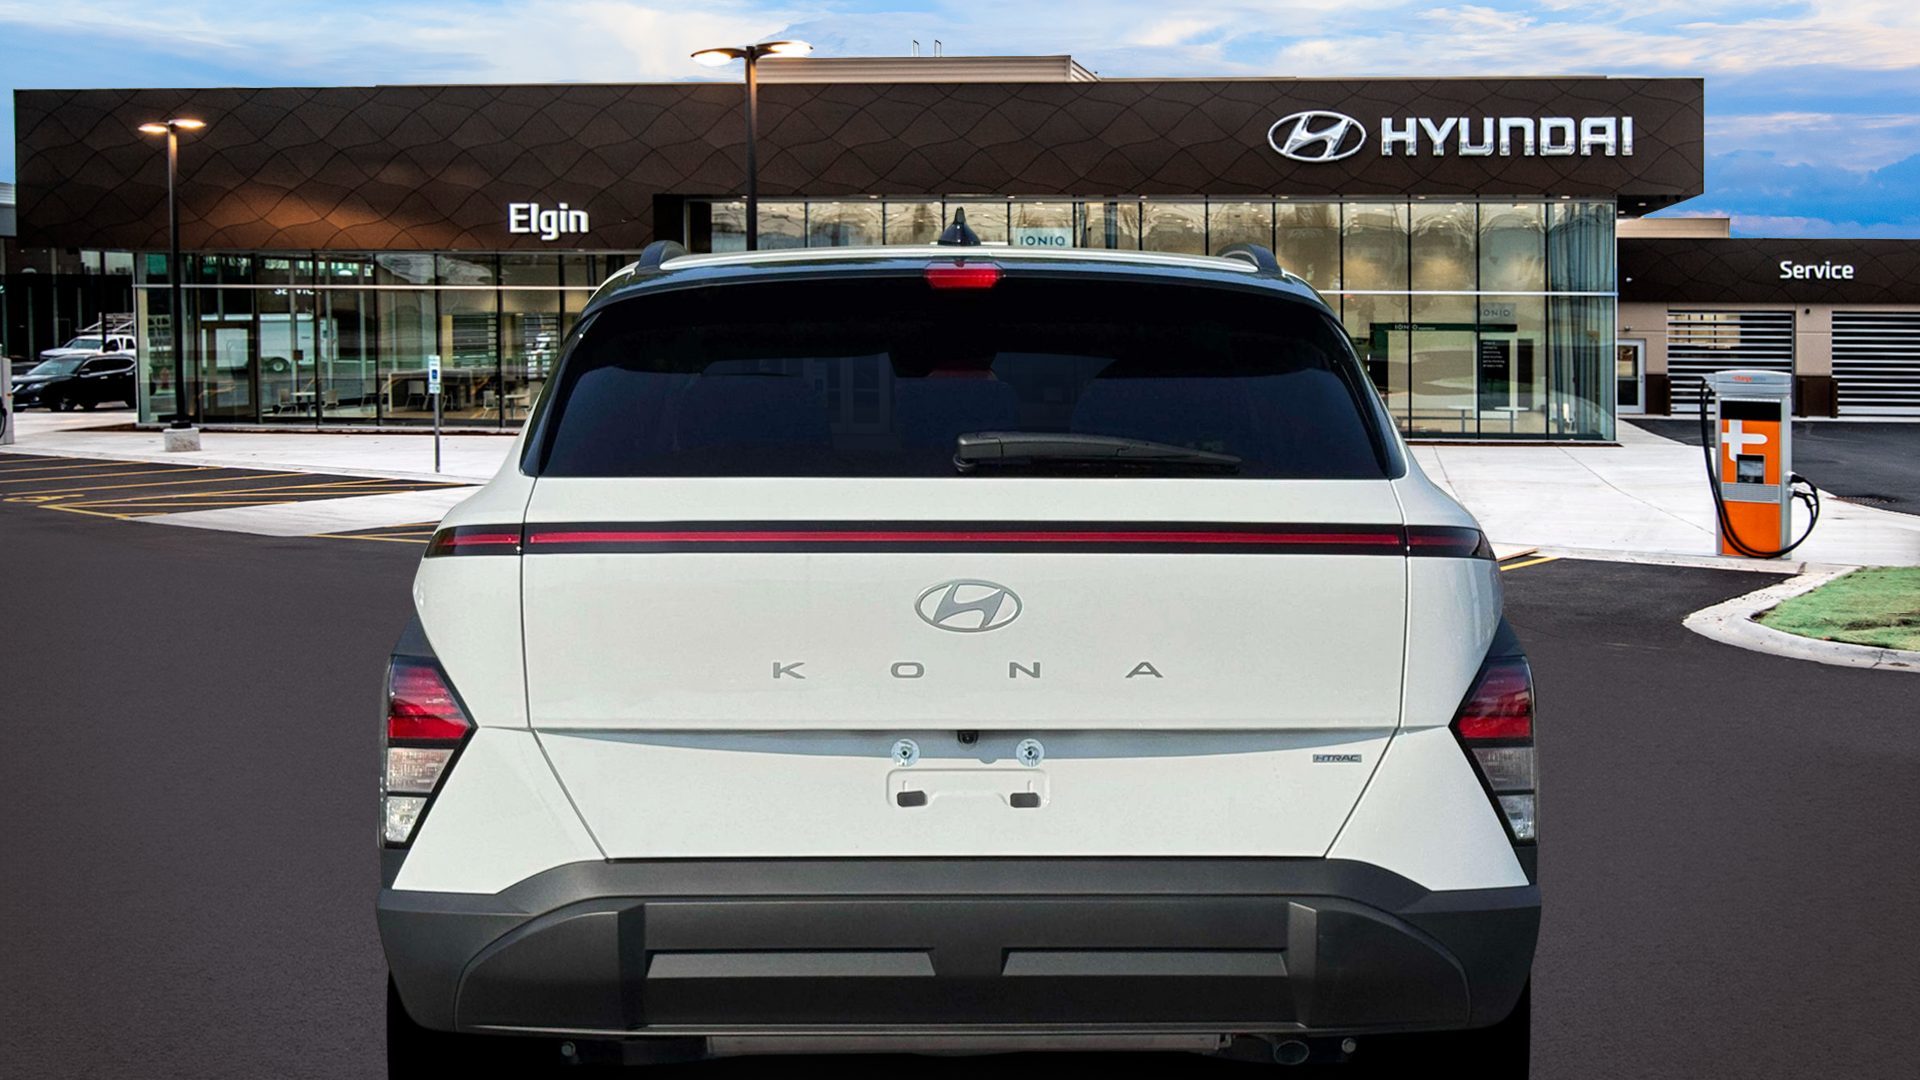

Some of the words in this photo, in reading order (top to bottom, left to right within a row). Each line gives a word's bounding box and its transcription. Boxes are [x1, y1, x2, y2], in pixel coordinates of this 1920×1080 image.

[1380, 116, 1634, 157] HYUNDAI
[508, 202, 589, 241] Elgin
[1020, 235, 1066, 247] IONIQ
[1779, 260, 1855, 280] Service
[772, 661, 1164, 680] KONA
[1314, 754, 1360, 763] HTRAC
